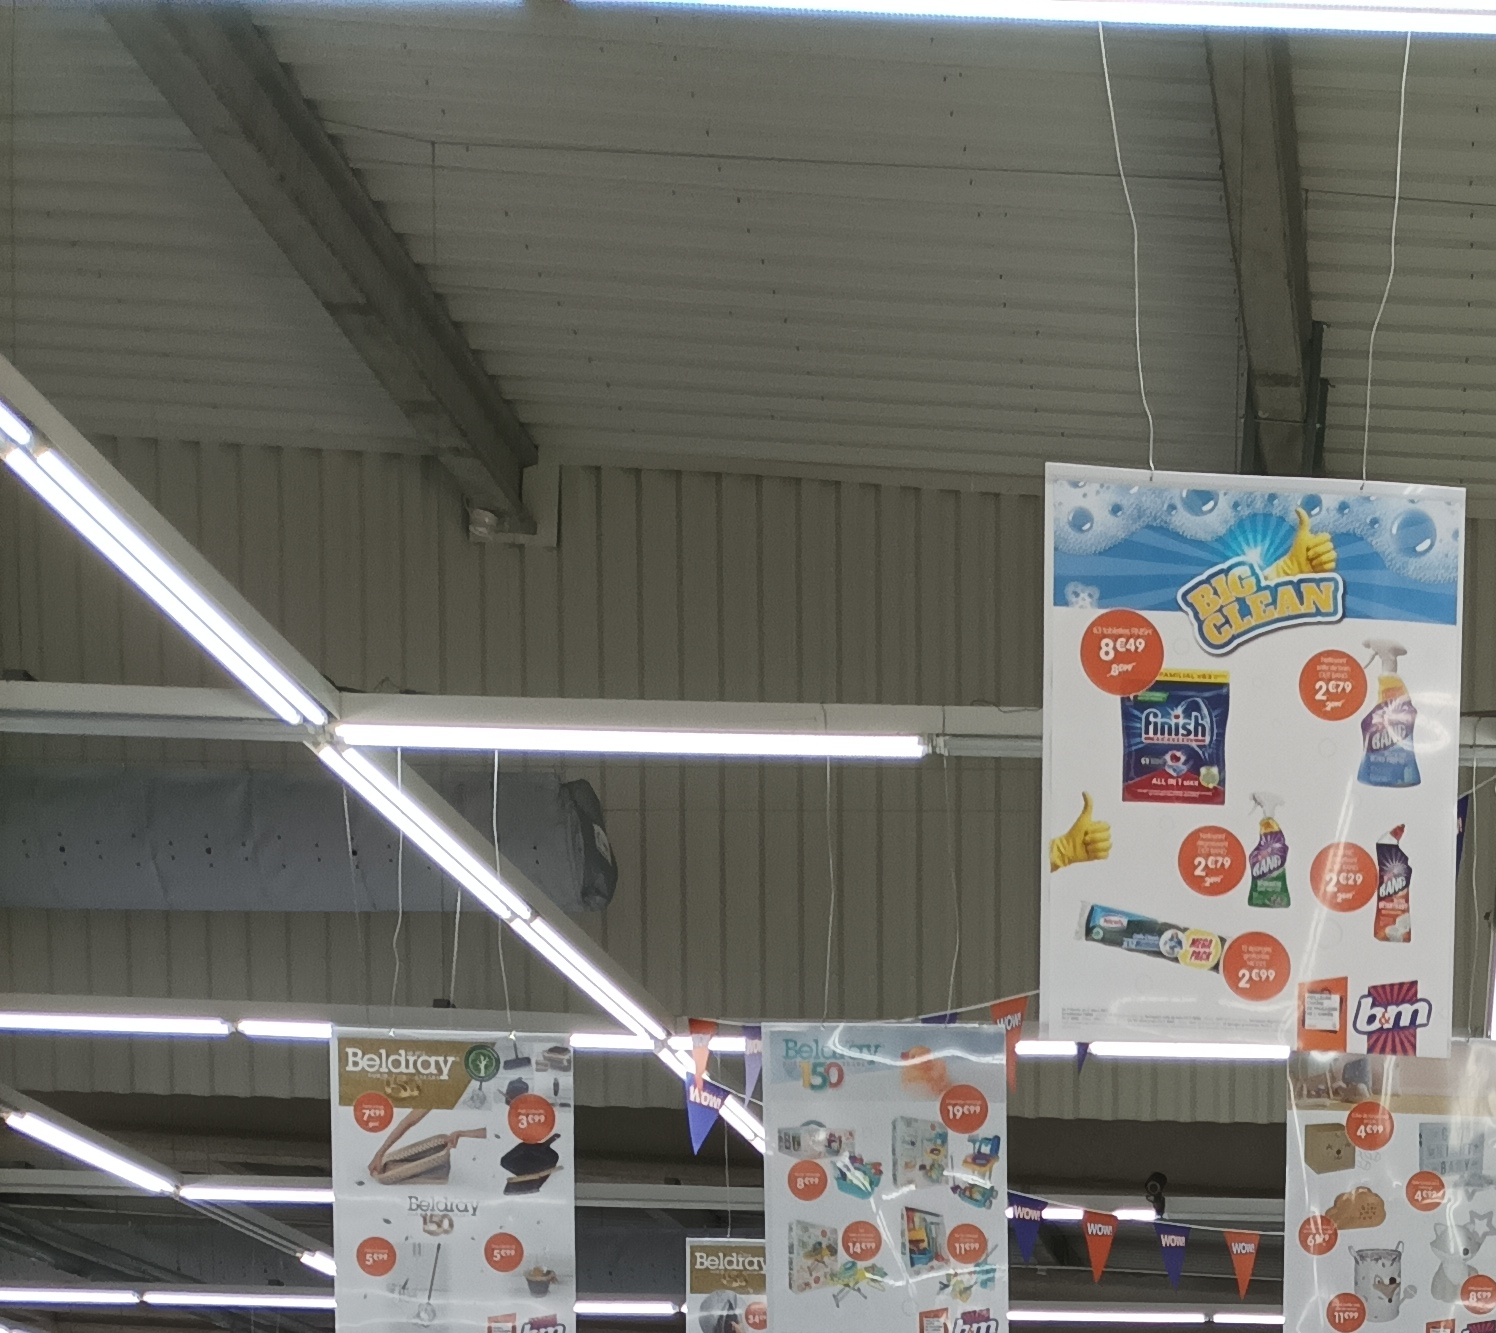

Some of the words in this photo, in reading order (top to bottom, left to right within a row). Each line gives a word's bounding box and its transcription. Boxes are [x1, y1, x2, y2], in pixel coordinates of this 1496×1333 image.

[1192, 565, 1257, 618] BIG
[1202, 578, 1337, 646] CLEAN
[1100, 638, 1145, 661] 8€49
[1314, 681, 1352, 700] 2€79
[1143, 709, 1206, 737] finish
[1194, 856, 1231, 876] 2€79
[1325, 874, 1363, 892] 2€29
[1189, 938, 1214, 950] MEGA
[1238, 968, 1276, 988] 2€99
[346, 1048, 456, 1079] Beldray
[801, 1061, 845, 1091] 150
[1087, 1223, 1113, 1236] WOW!
